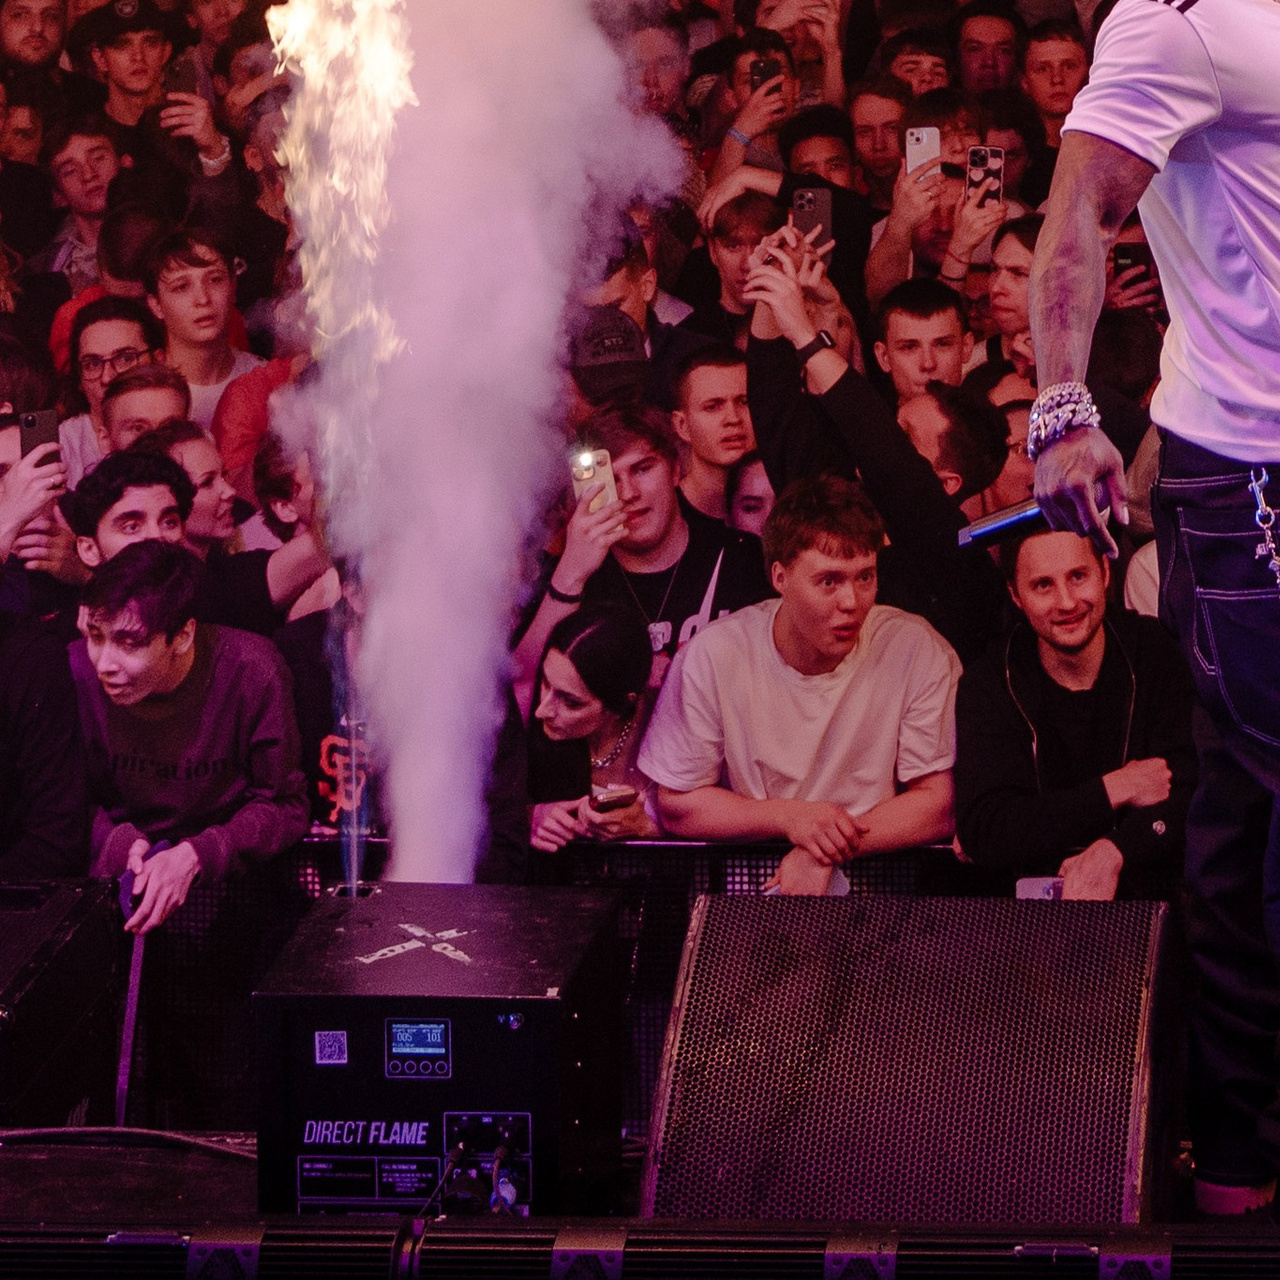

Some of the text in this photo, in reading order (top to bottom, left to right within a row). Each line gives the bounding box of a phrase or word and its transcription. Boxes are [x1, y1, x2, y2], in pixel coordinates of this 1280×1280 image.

[426, 1032, 441, 1042] 101
[303, 1120, 430, 1145] DIRECT FLAME
